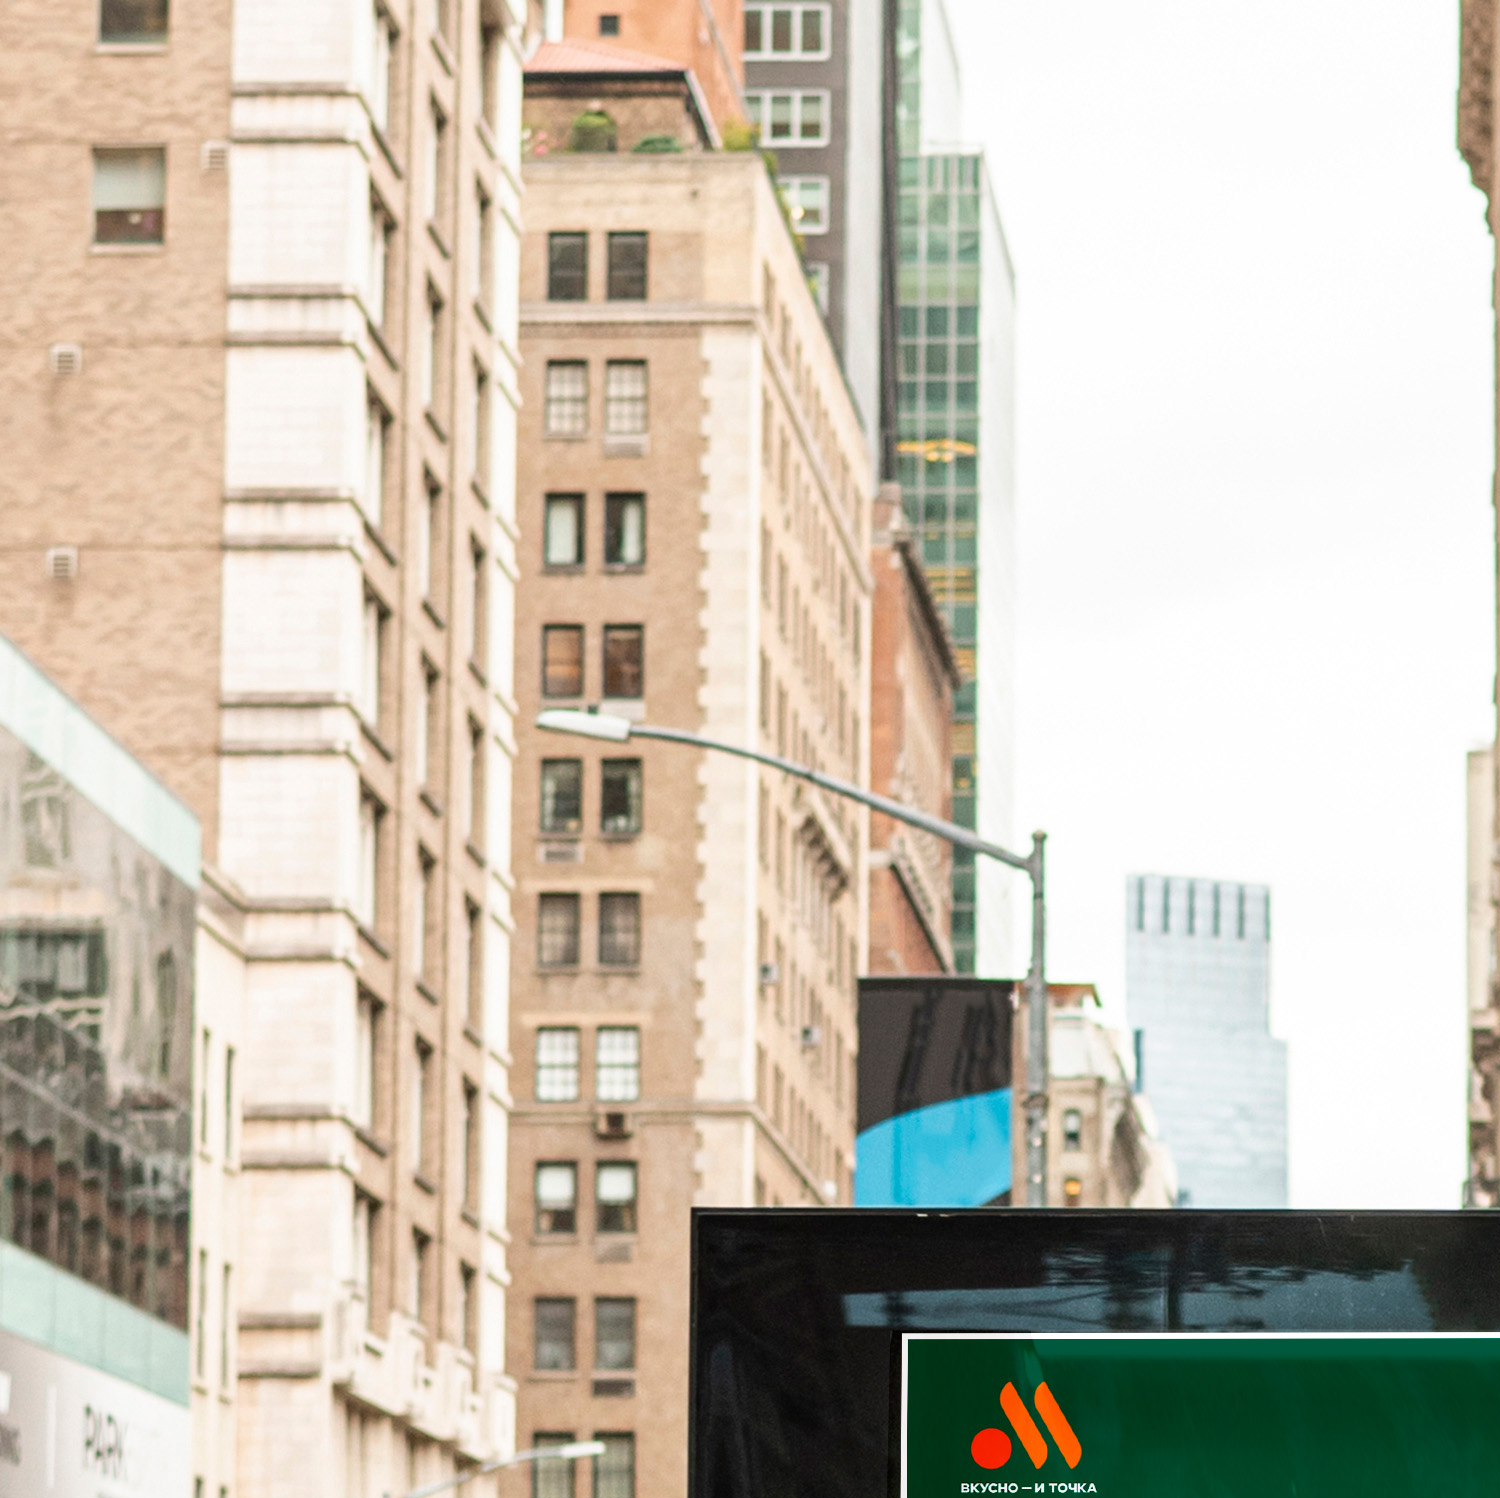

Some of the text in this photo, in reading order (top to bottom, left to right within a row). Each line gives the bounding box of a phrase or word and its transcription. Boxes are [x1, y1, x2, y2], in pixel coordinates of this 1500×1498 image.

[961, 1483, 1019, 1494] ВКУСНО
[1034, 1483, 1045, 1493] И
[1048, 1483, 1098, 1493] ТОЧКА
